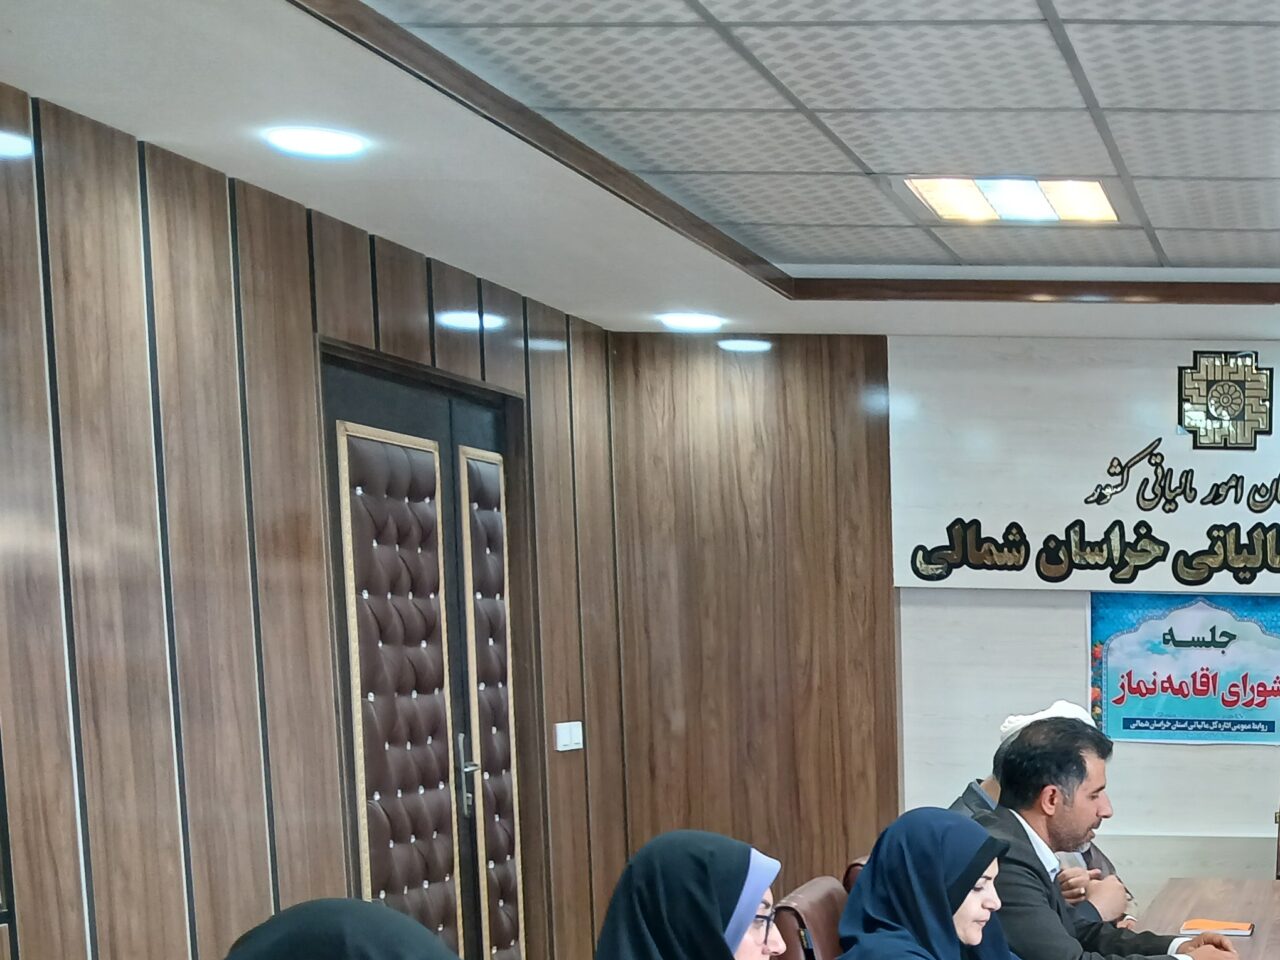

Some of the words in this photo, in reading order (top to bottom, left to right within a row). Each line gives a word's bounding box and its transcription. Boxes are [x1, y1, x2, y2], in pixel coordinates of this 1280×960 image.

[1084, 437, 1163, 505] کشور
[1136, 452, 1198, 513] مالیاتی
[1200, 474, 1244, 505] امور
[911, 517, 1030, 581] شمالی
[1035, 519, 1170, 583] خراسان
[1162, 625, 1237, 655] جلسه
[1111, 669, 1157, 705] نماز
[1160, 666, 1219, 699] اقامه
[1130, 719, 1150, 729] شمالی
[1150, 719, 1172, 730] خراسان
